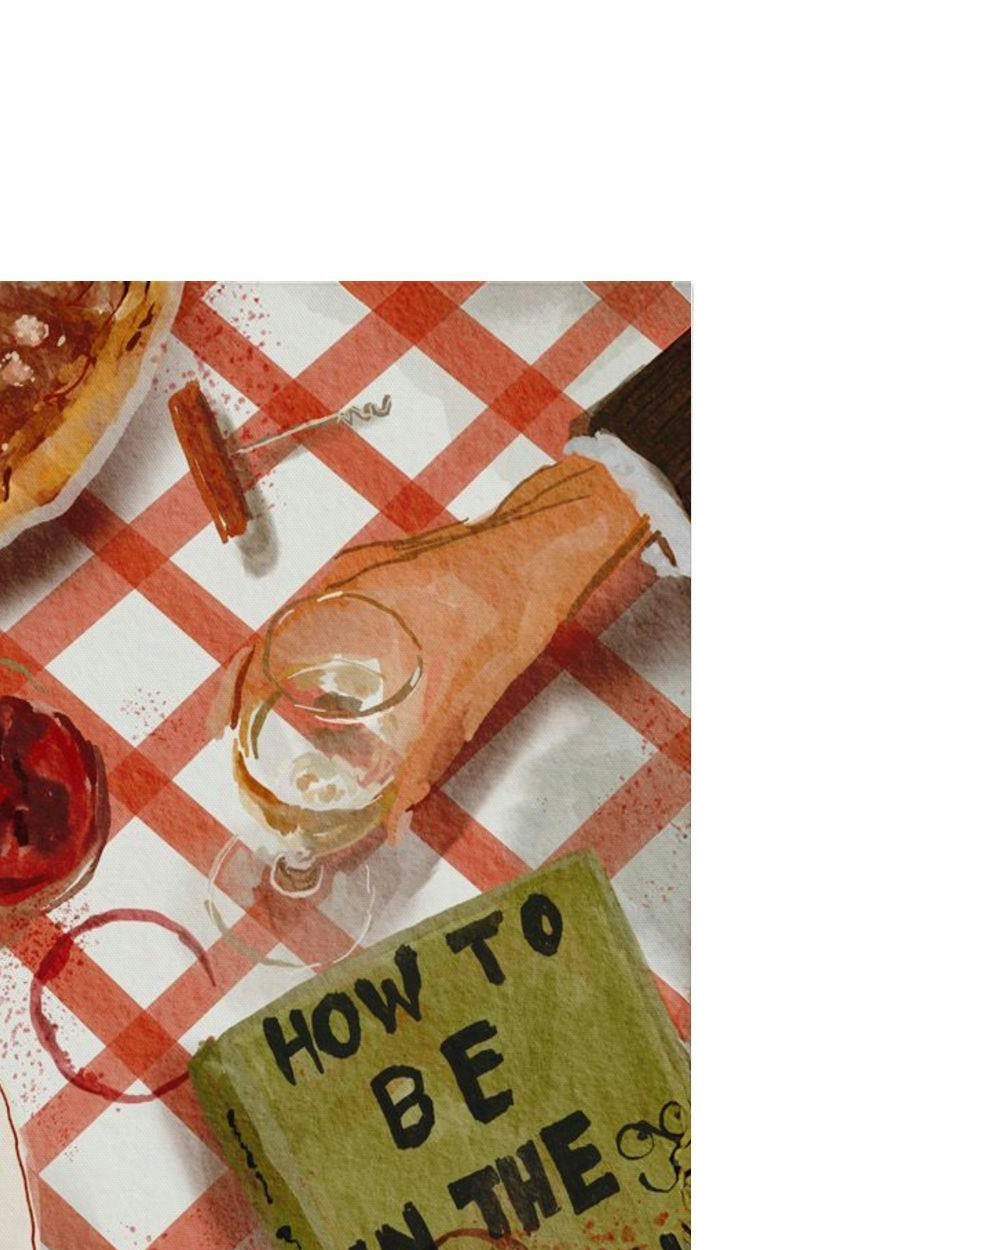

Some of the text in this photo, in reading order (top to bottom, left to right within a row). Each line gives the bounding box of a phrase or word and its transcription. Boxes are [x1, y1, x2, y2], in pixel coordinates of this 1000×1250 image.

[263, 893, 564, 1086] HOW TO
[369, 1018, 514, 1150] BE
[447, 1109, 619, 1240] THE
